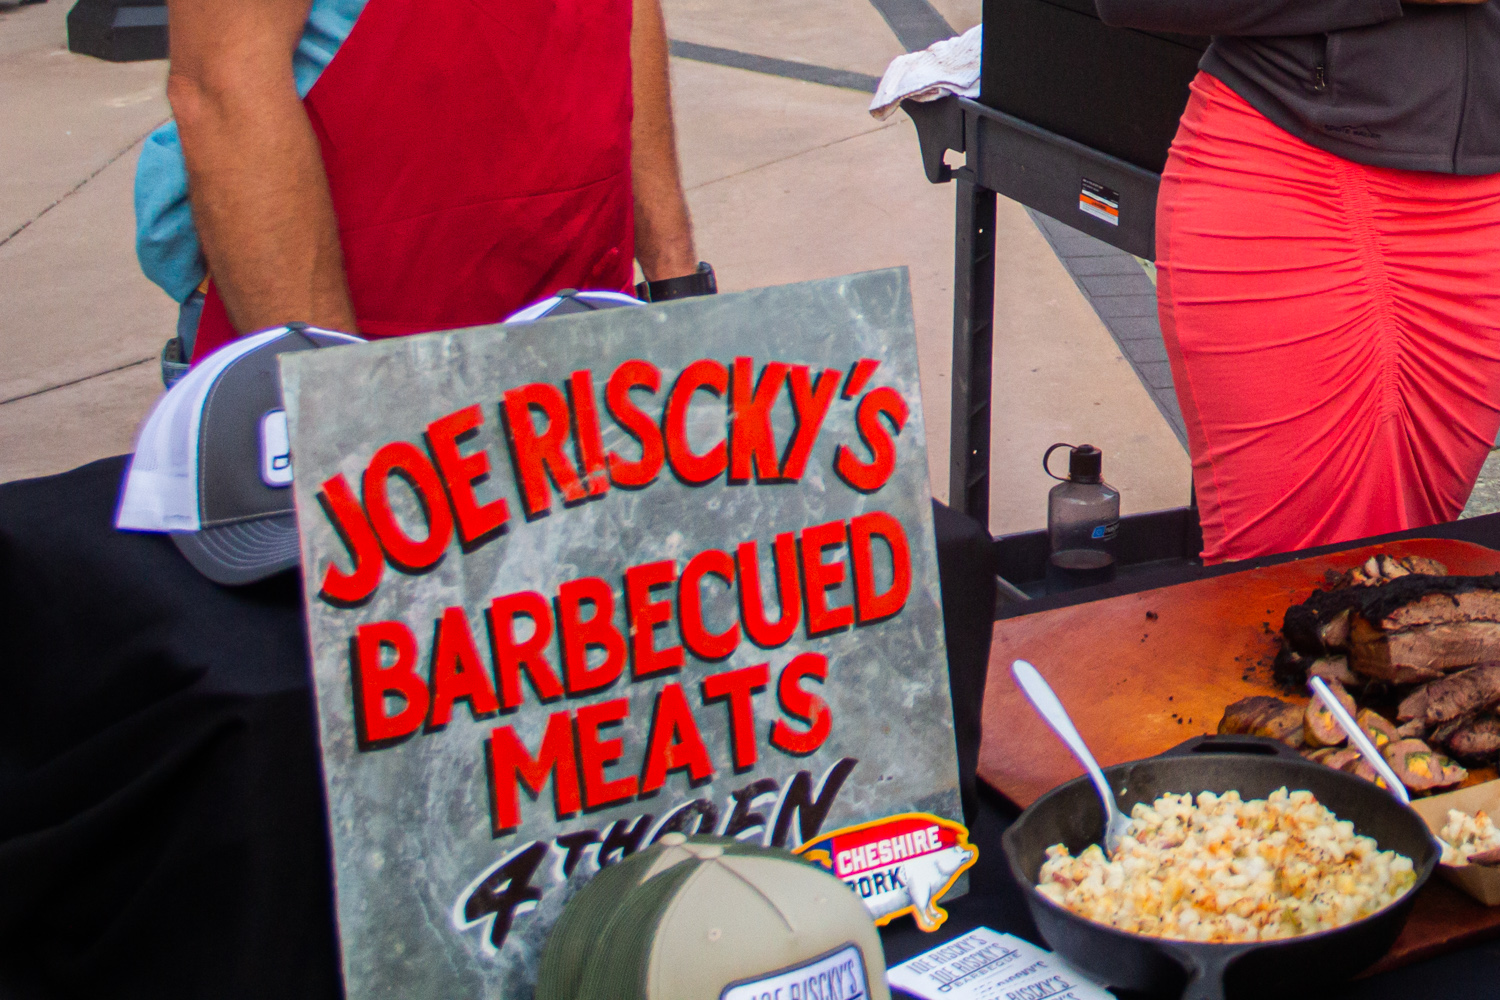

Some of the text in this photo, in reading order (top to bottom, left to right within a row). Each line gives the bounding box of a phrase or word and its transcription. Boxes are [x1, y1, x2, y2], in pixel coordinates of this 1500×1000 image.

[317, 356, 911, 609] JOE RISCKY'S
[350, 511, 913, 752] BARBECUED
[487, 652, 834, 839] MEATS
[837, 825, 942, 876] CHESHIRE
[928, 934, 988, 965] RISCKY'S
[950, 942, 1011, 976] RISCKY'S
[954, 951, 1023, 988] BARBEQUE
